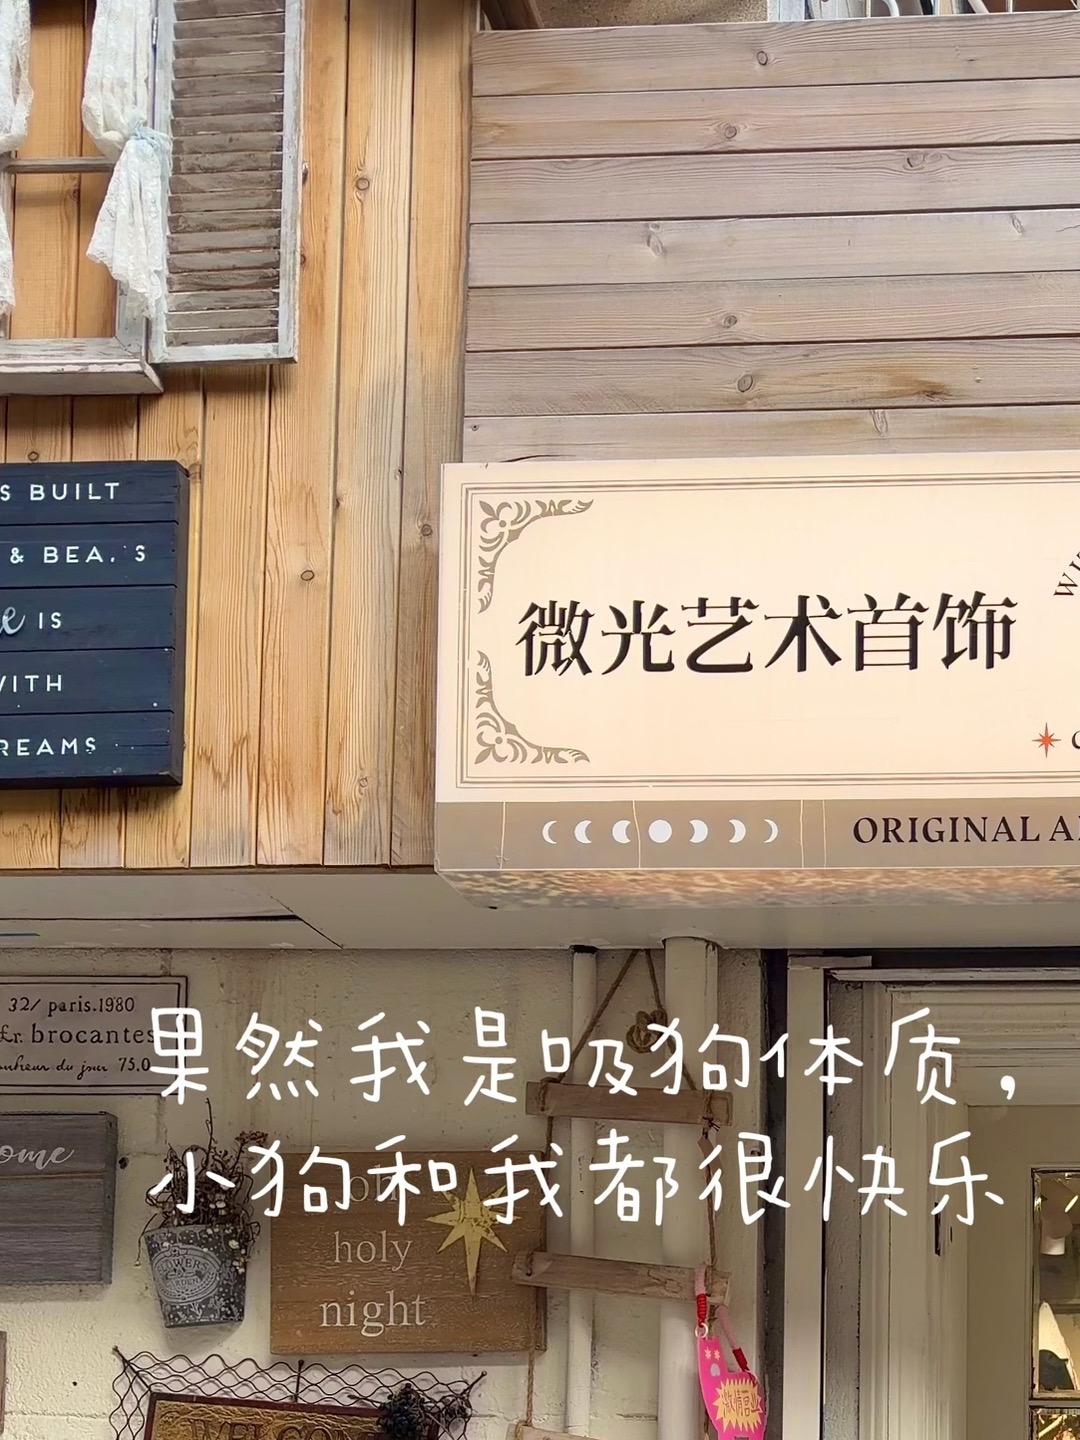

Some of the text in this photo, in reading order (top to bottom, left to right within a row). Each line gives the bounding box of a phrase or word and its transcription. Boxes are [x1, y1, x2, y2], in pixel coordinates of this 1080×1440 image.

[29, 482, 120, 501] BUILT
[10, 544, 146, 564] & BEAS
[38, 612, 62, 629] IS
[515, 590, 1018, 677] 微光艺术首饰
[853, 816, 1040, 844] ORIGINAL
[56, 1058, 73, 1072] du
[333, 1230, 414, 1272] holy
[319, 1289, 427, 1337] night
